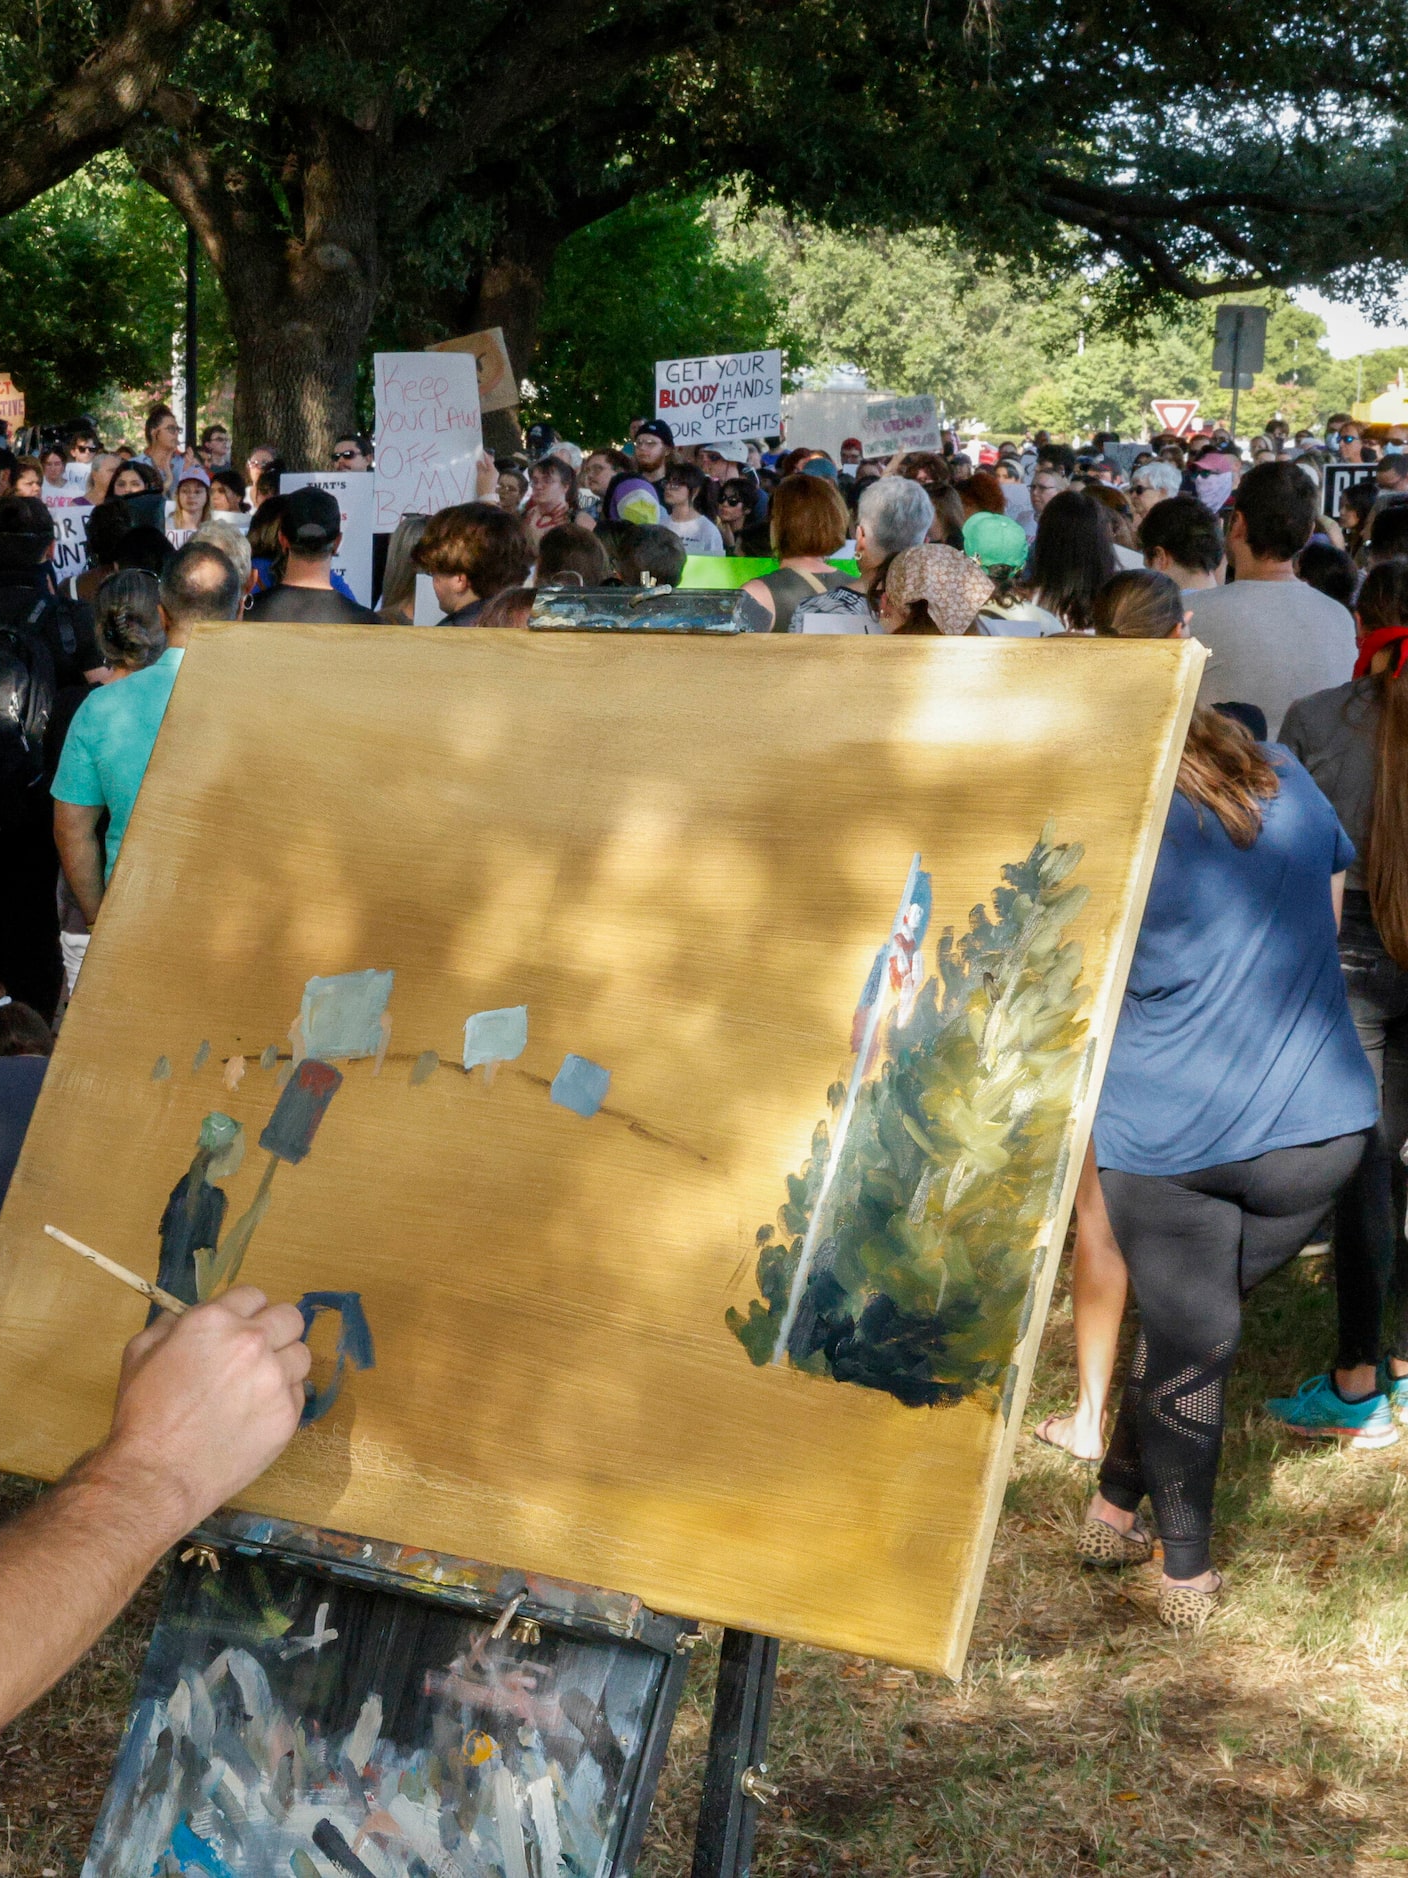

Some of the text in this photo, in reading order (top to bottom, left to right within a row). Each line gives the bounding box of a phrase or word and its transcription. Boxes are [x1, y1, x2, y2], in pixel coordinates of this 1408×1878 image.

[666, 355, 765, 383] GET YOUR
[658, 379, 774, 408] BLOODY HANDS
[702, 401, 738, 420] OFF
[715, 413, 780, 436] RIGHTS
[378, 442, 441, 480] OFF
